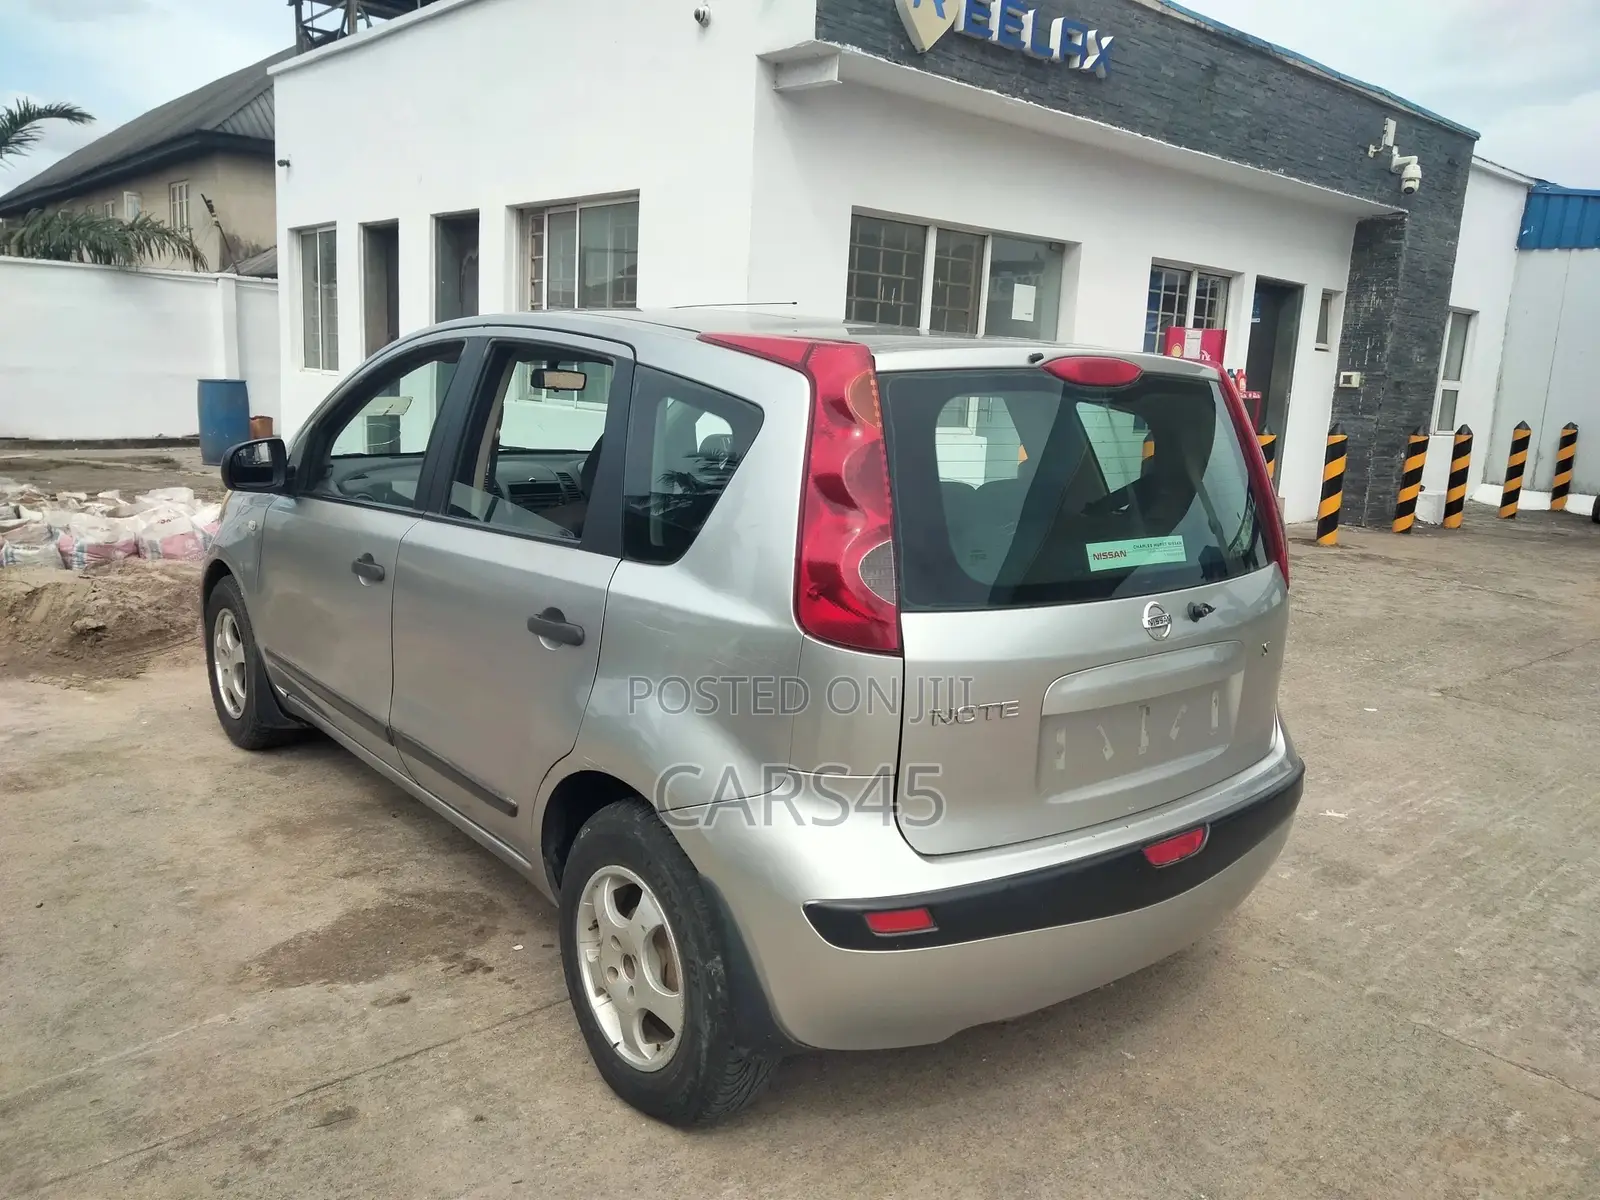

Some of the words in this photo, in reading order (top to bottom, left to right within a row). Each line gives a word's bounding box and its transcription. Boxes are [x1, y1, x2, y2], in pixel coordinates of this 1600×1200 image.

[1093, 550, 1127, 561] NISSAN
[1148, 614, 1171, 627] NISSAN
[929, 700, 1020, 727] NOTE
